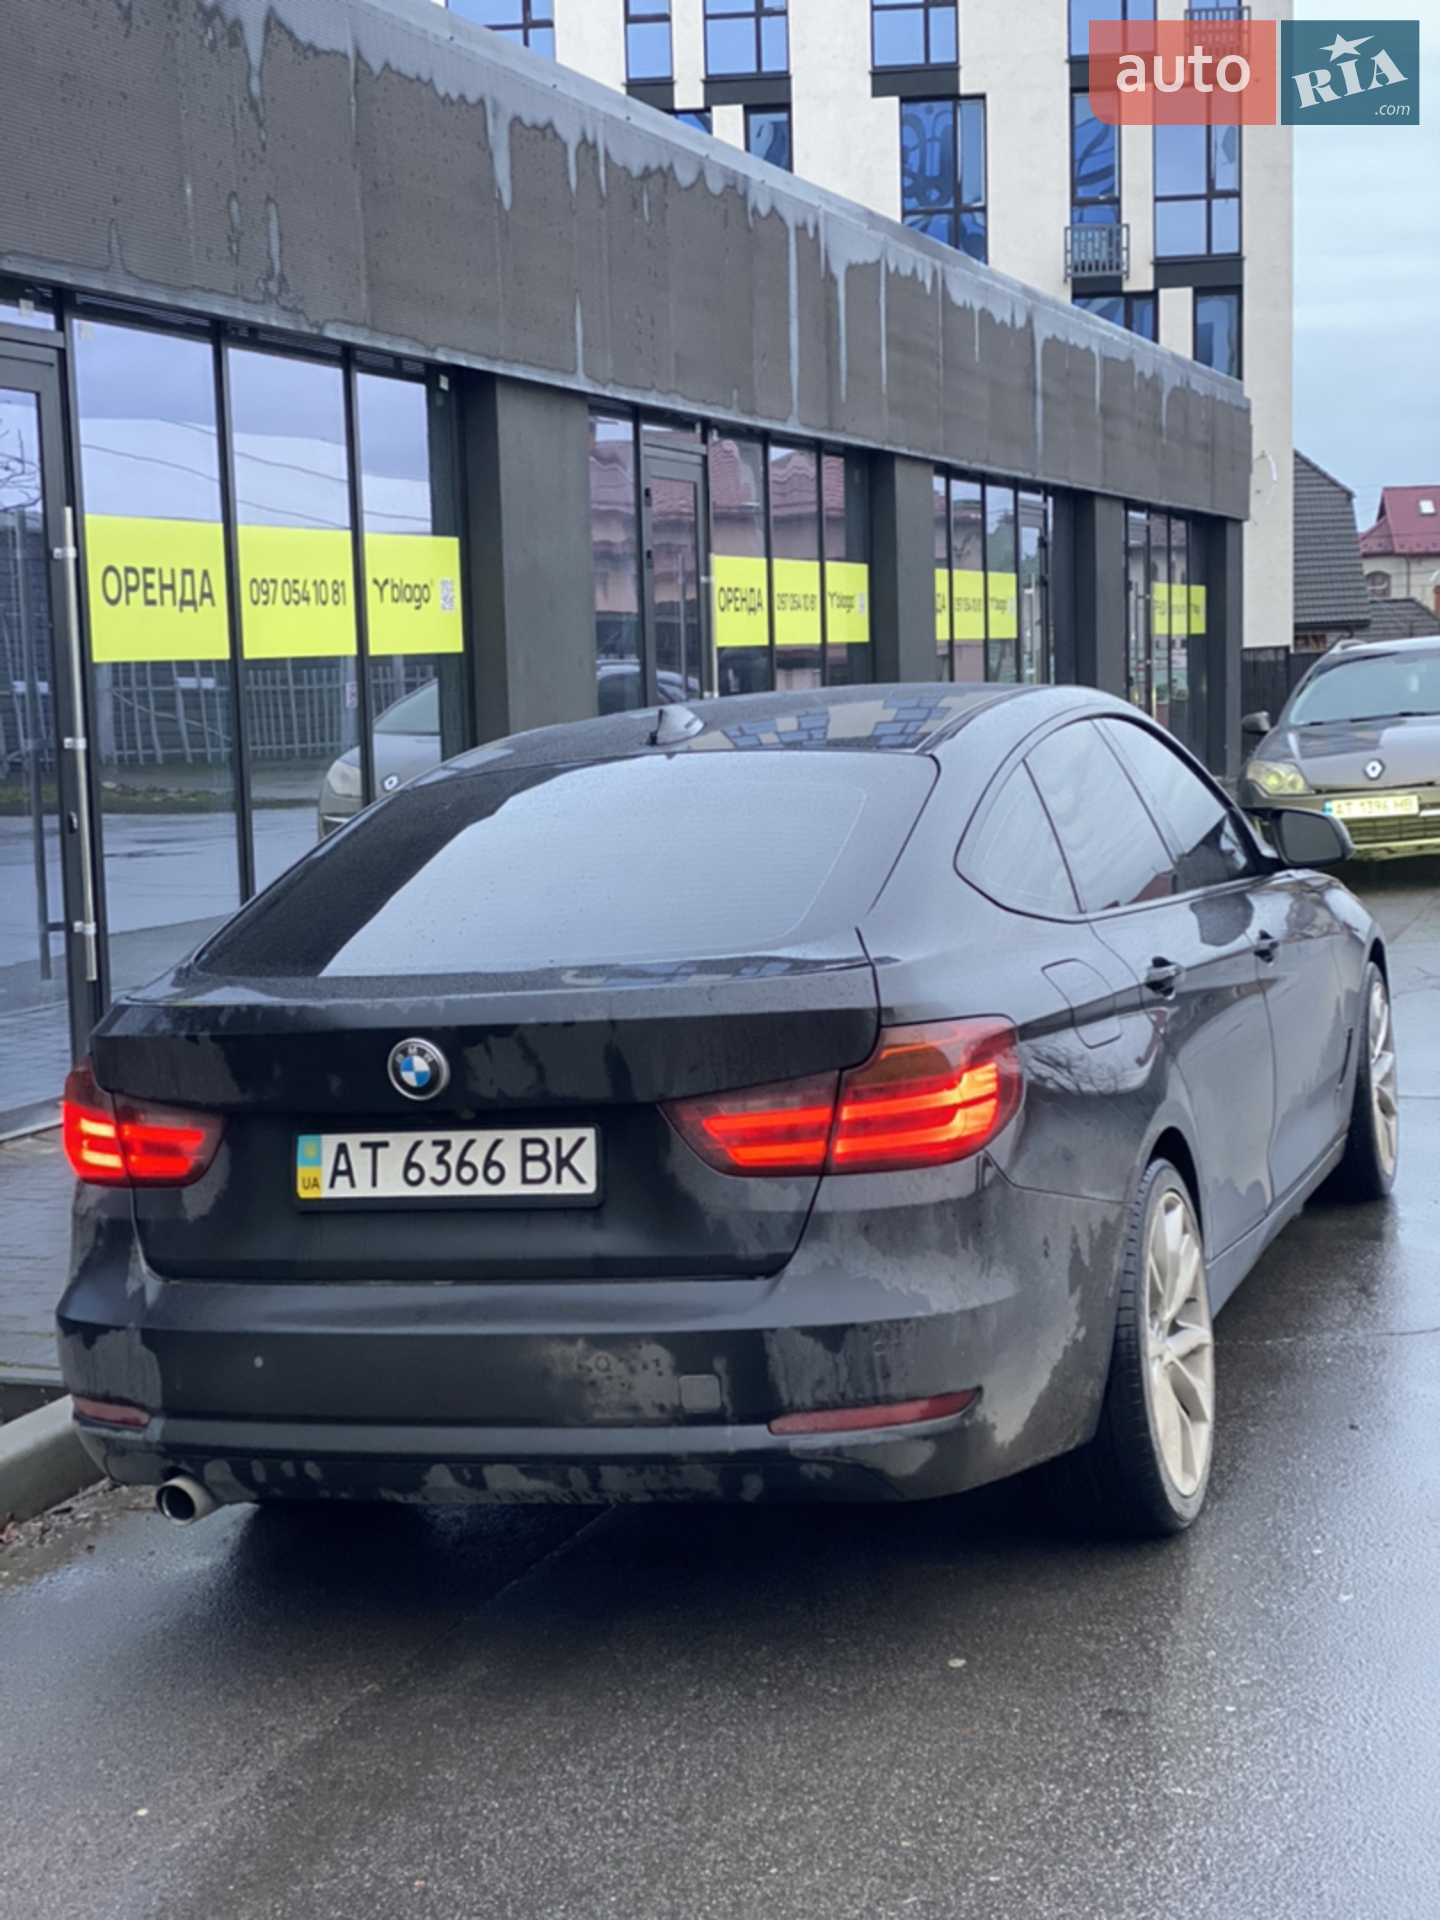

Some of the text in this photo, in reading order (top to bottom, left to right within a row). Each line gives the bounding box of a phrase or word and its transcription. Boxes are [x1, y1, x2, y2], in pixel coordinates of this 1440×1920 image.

[101, 565, 216, 613] ОРЕНДА
[249, 577, 347, 606] 097 054 10 81
[718, 586, 763, 616] ОРЕНДА
[395, 1044, 434, 1063] BMW
[328, 1136, 588, 1189] AT 6366 BK
[301, 1177, 320, 1190] UA
